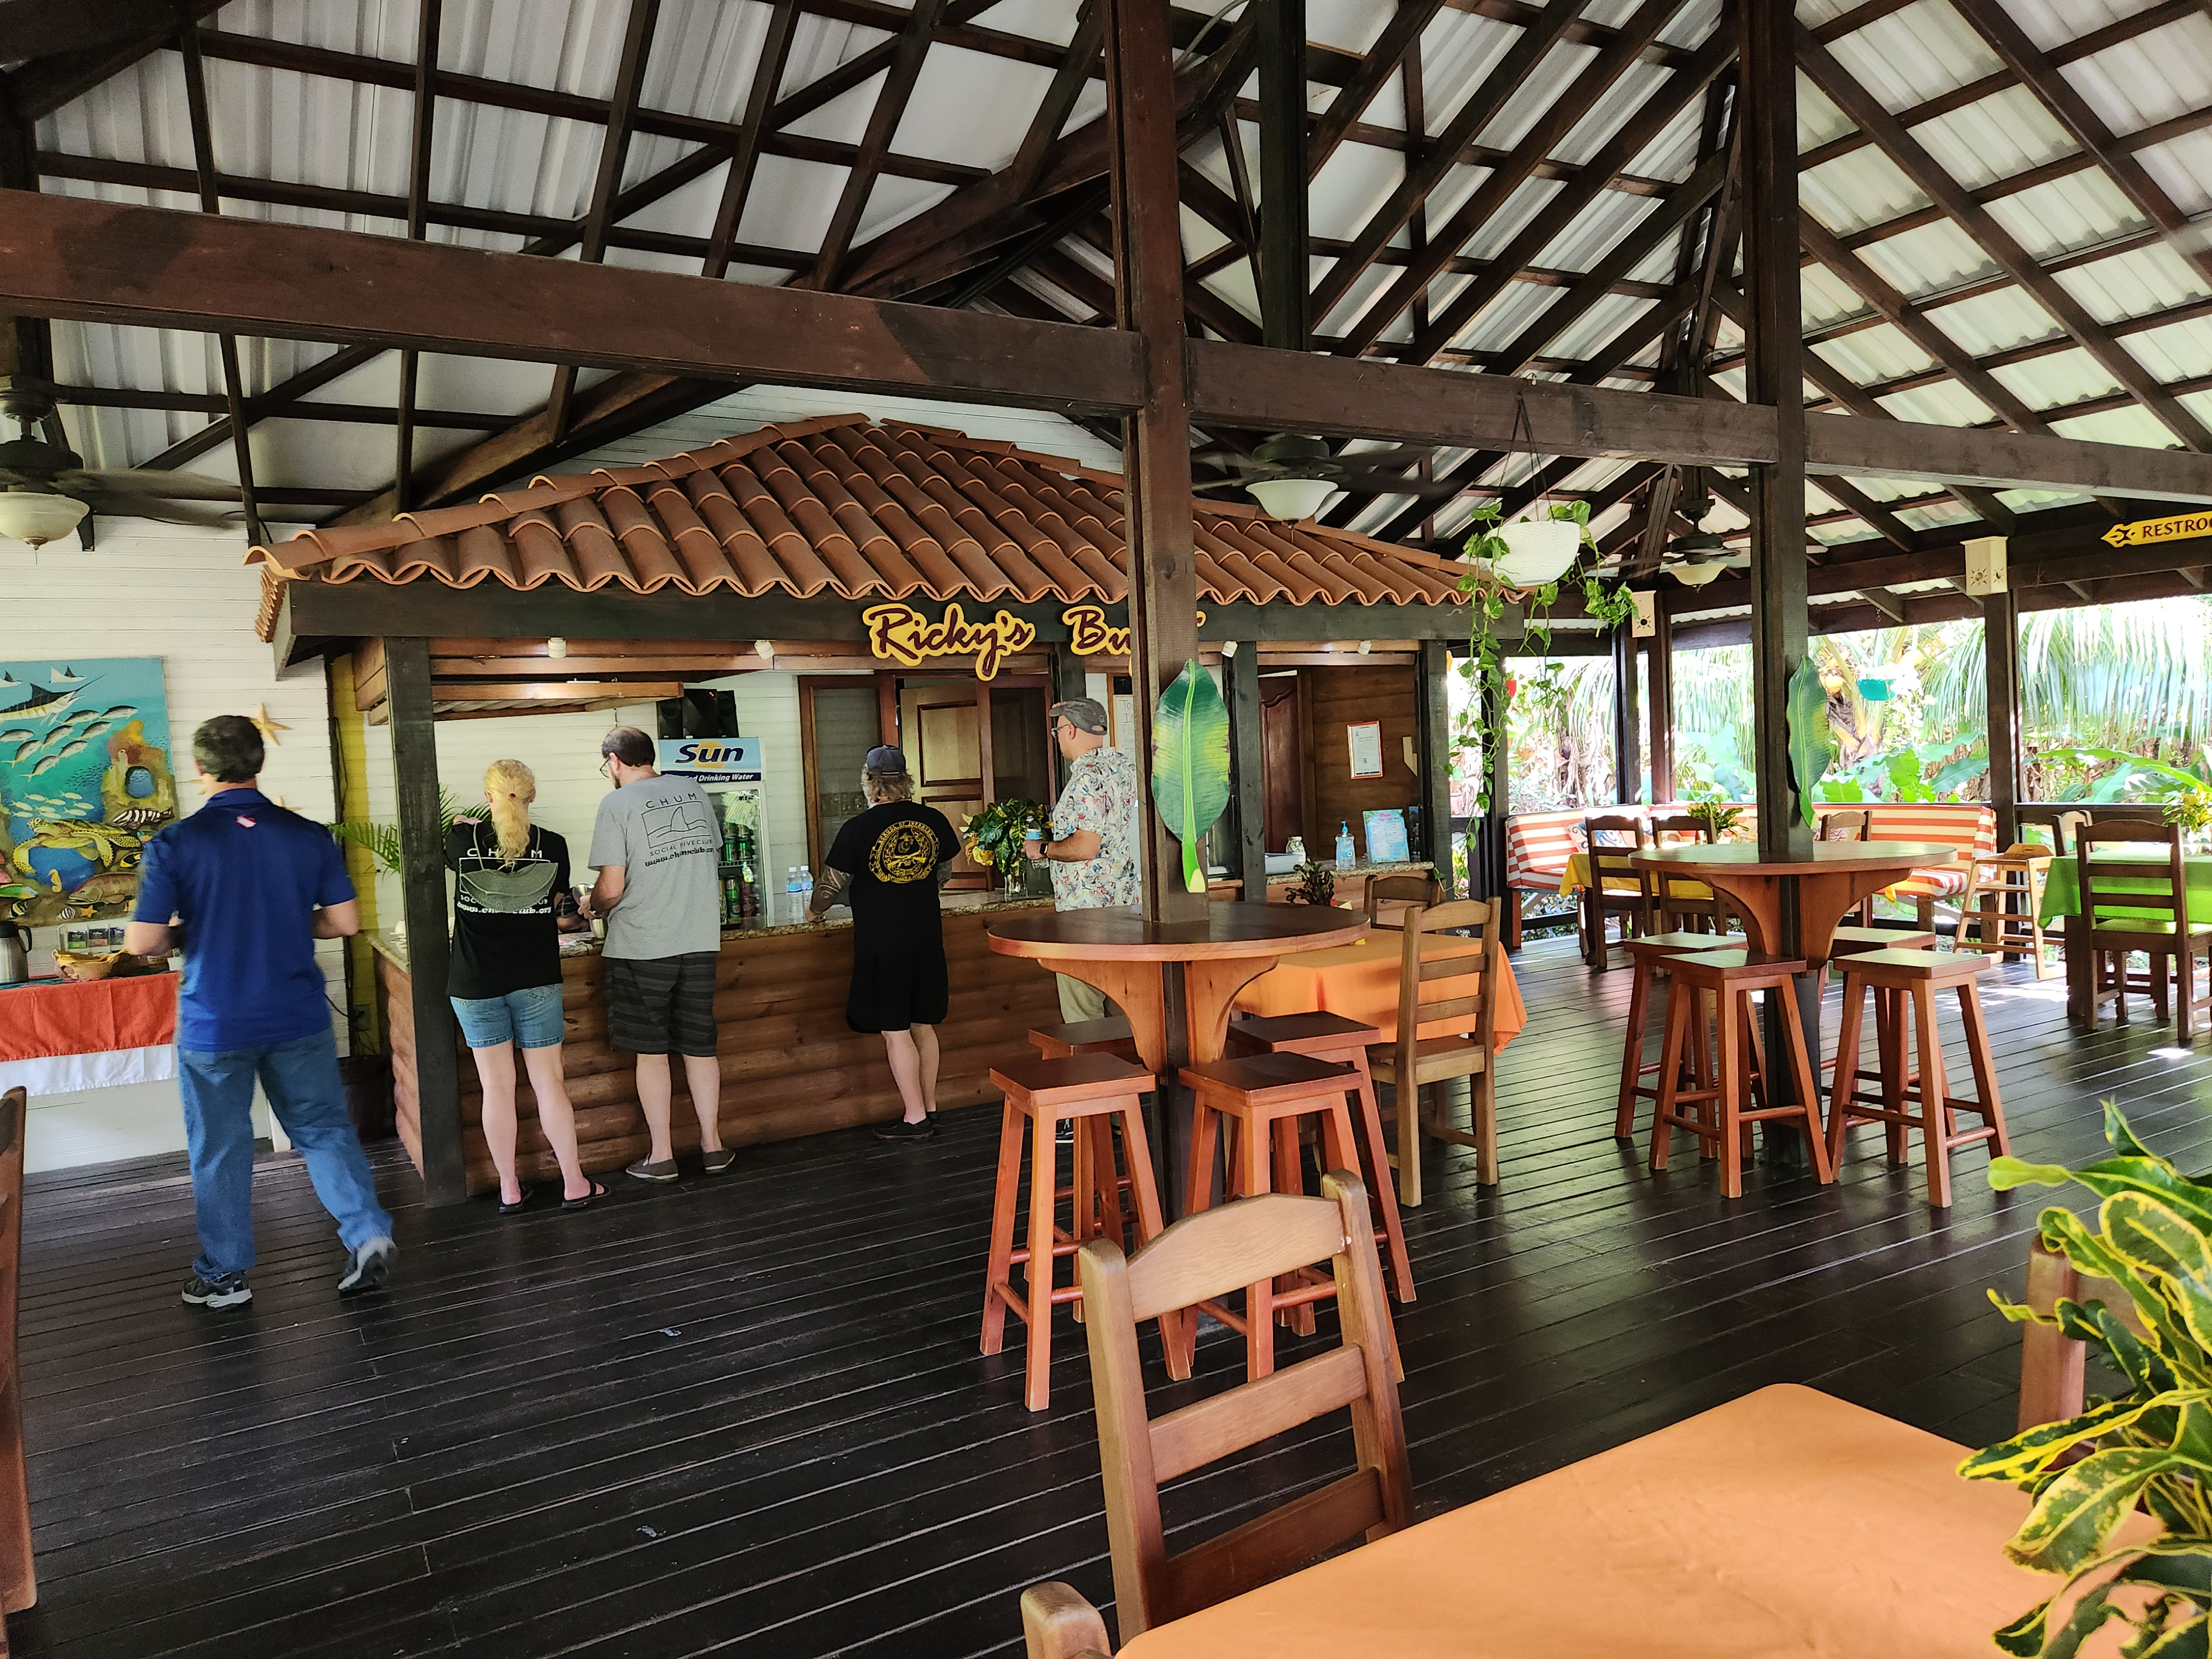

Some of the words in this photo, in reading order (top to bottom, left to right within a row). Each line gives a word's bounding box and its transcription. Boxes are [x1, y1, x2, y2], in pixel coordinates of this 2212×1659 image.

[2142, 518, 2212, 539] RESTRO
[868, 608, 1032, 677] Ricky's
[675, 743, 744, 764] Sun
[646, 792, 697, 808] CHUM
[467, 848, 542, 859] CHM
[650, 844, 677, 857] SOCIAL
